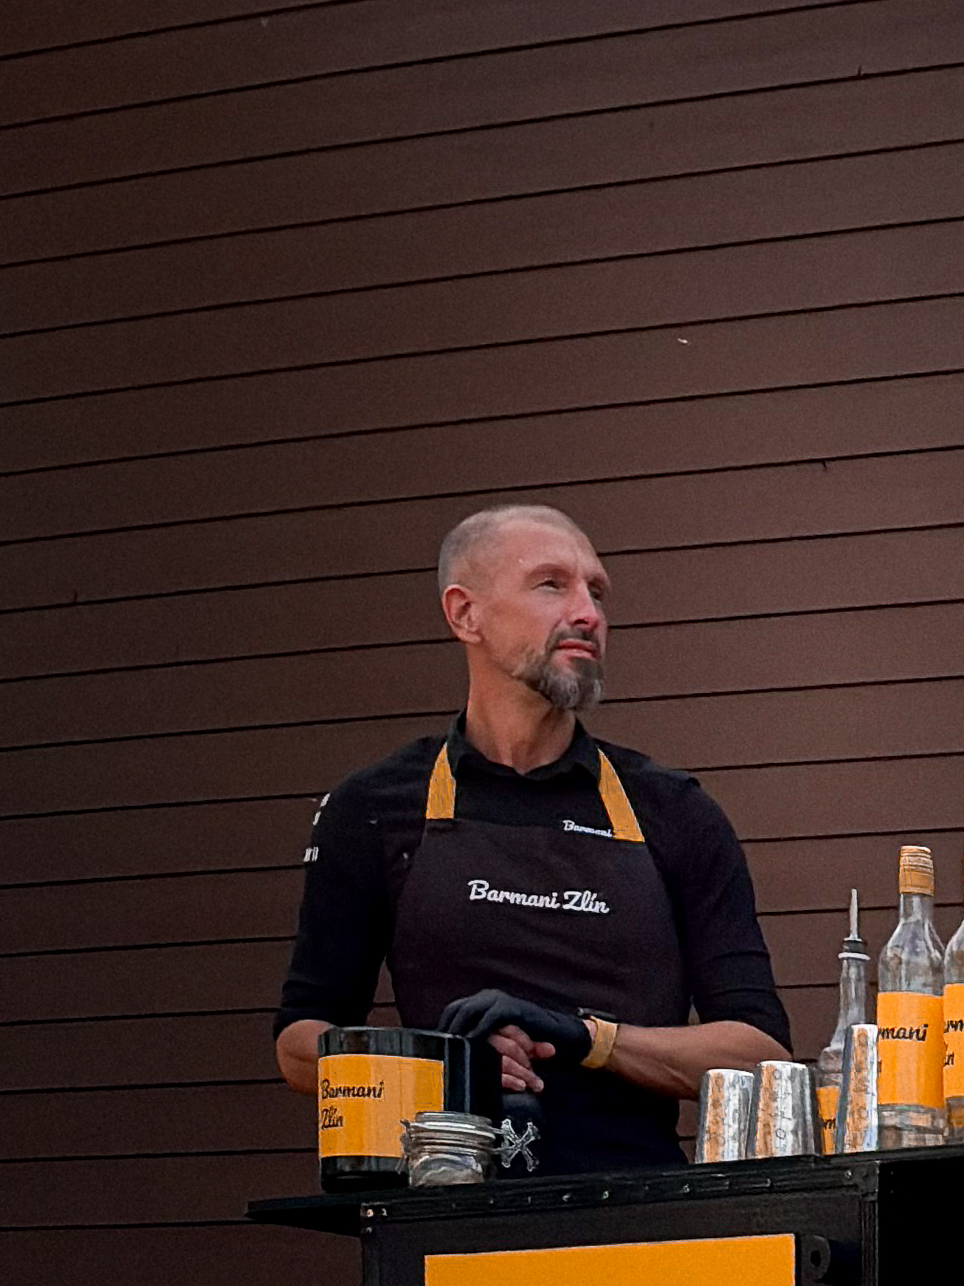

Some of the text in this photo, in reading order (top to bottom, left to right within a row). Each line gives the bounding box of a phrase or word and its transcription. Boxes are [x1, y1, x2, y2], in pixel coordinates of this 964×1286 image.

[467, 879, 610, 914] Barmani Zlín
[320, 1079, 385, 1100] Barmani
